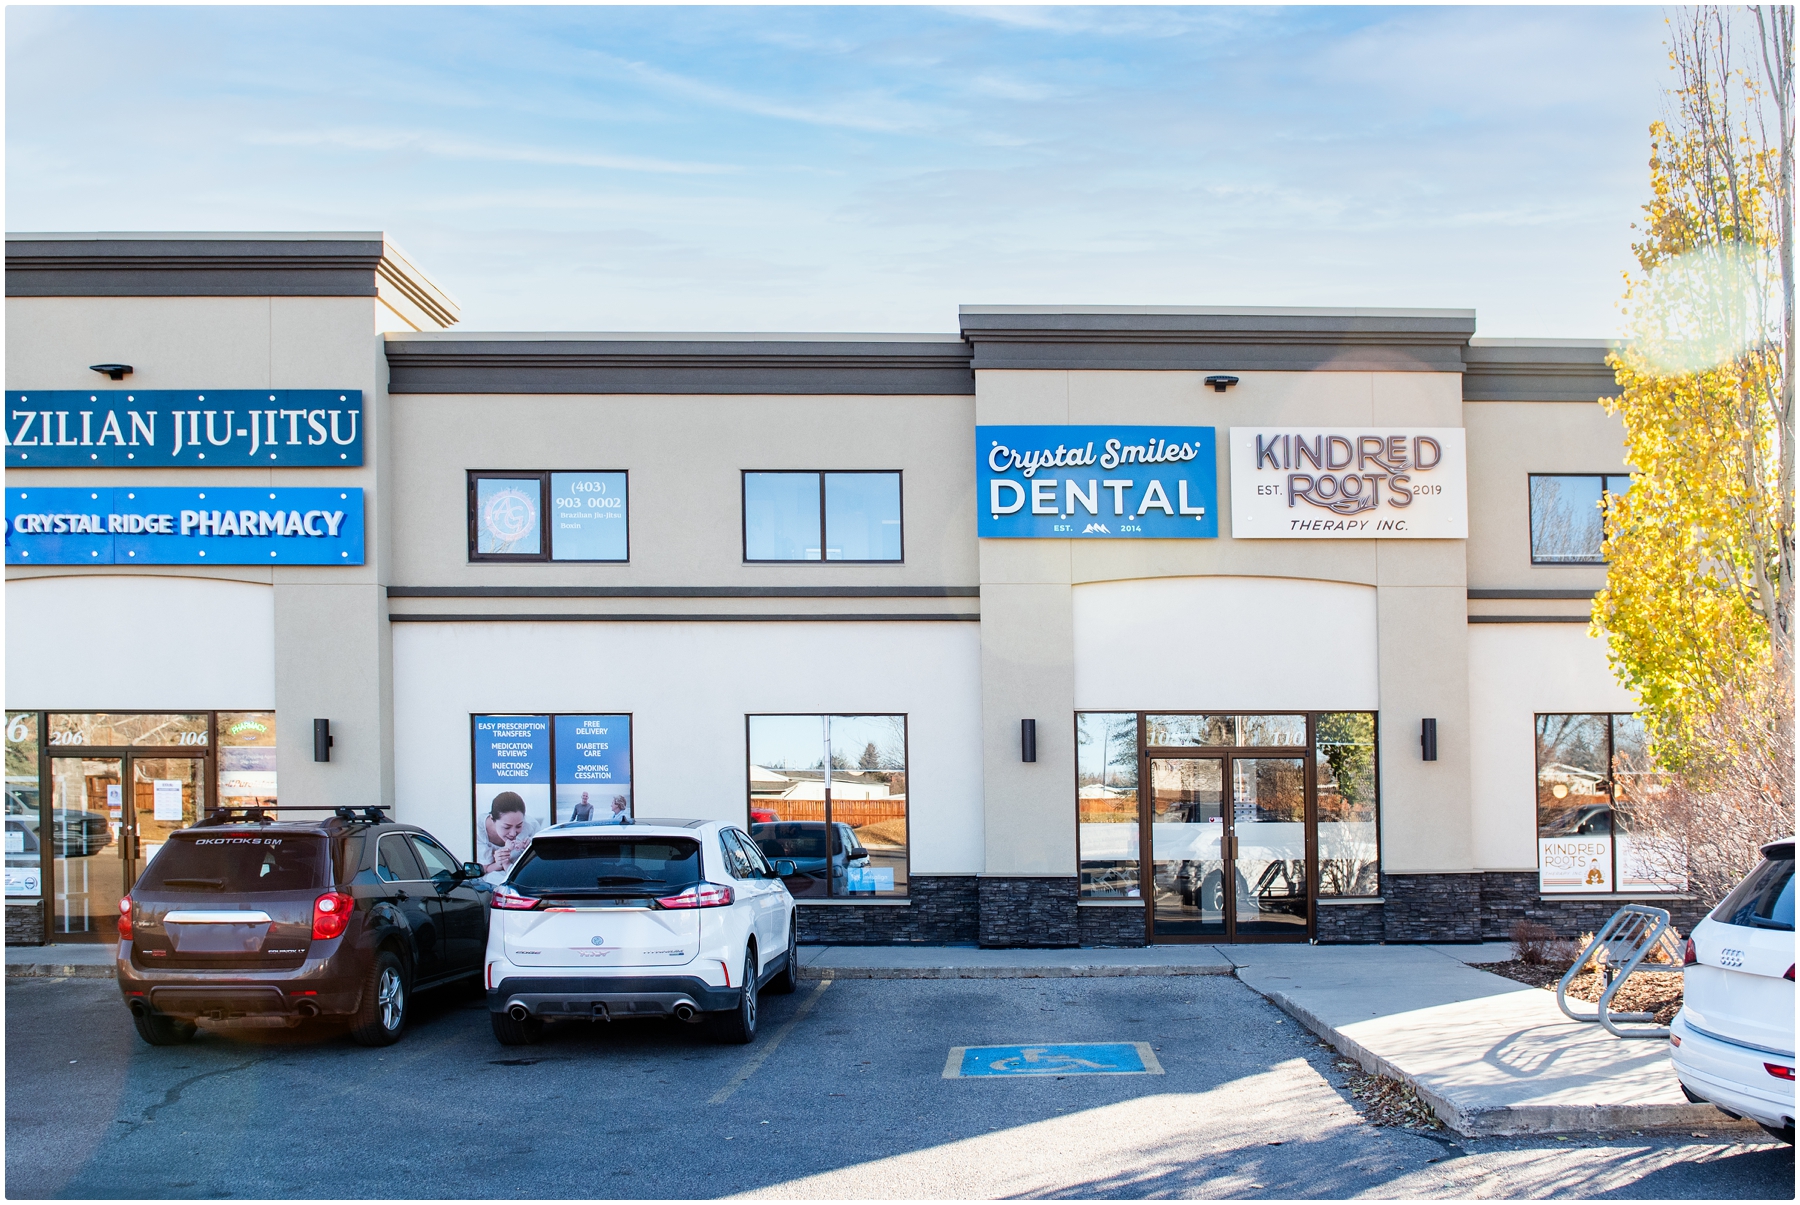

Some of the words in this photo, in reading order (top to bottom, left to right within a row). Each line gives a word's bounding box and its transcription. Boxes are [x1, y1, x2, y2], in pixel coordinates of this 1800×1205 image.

[5, 410, 157, 446] ZILIAN
[172, 409, 359, 457] JIU-JITSU
[989, 442, 1097, 478] Crystal
[1100, 438, 1198, 469] Smiles
[1256, 434, 1442, 473] KINDRED
[571, 481, 606, 494] (403)
[1257, 485, 1282, 495] EST.
[1288, 473, 1413, 515] ROOTS
[1413, 485, 1442, 495] 2019
[556, 498, 581, 509] 903
[587, 498, 621, 508] 0002
[990, 479, 1205, 515] DENTAL
[14, 513, 107, 534] CRYSTAL
[108, 513, 173, 534] RIDGE
[180, 510, 345, 536] PHARMACY
[1290, 520, 1369, 531] THERAPY
[1376, 520, 1409, 531] INC.
[5, 714, 29, 743] 6
[231, 721, 268, 735] PHARMACY
[51, 731, 83, 745] 206
[177, 731, 208, 745] 106
[1544, 843, 1606, 855] KINDRED
[1545, 856, 1586, 870] ROOTS
